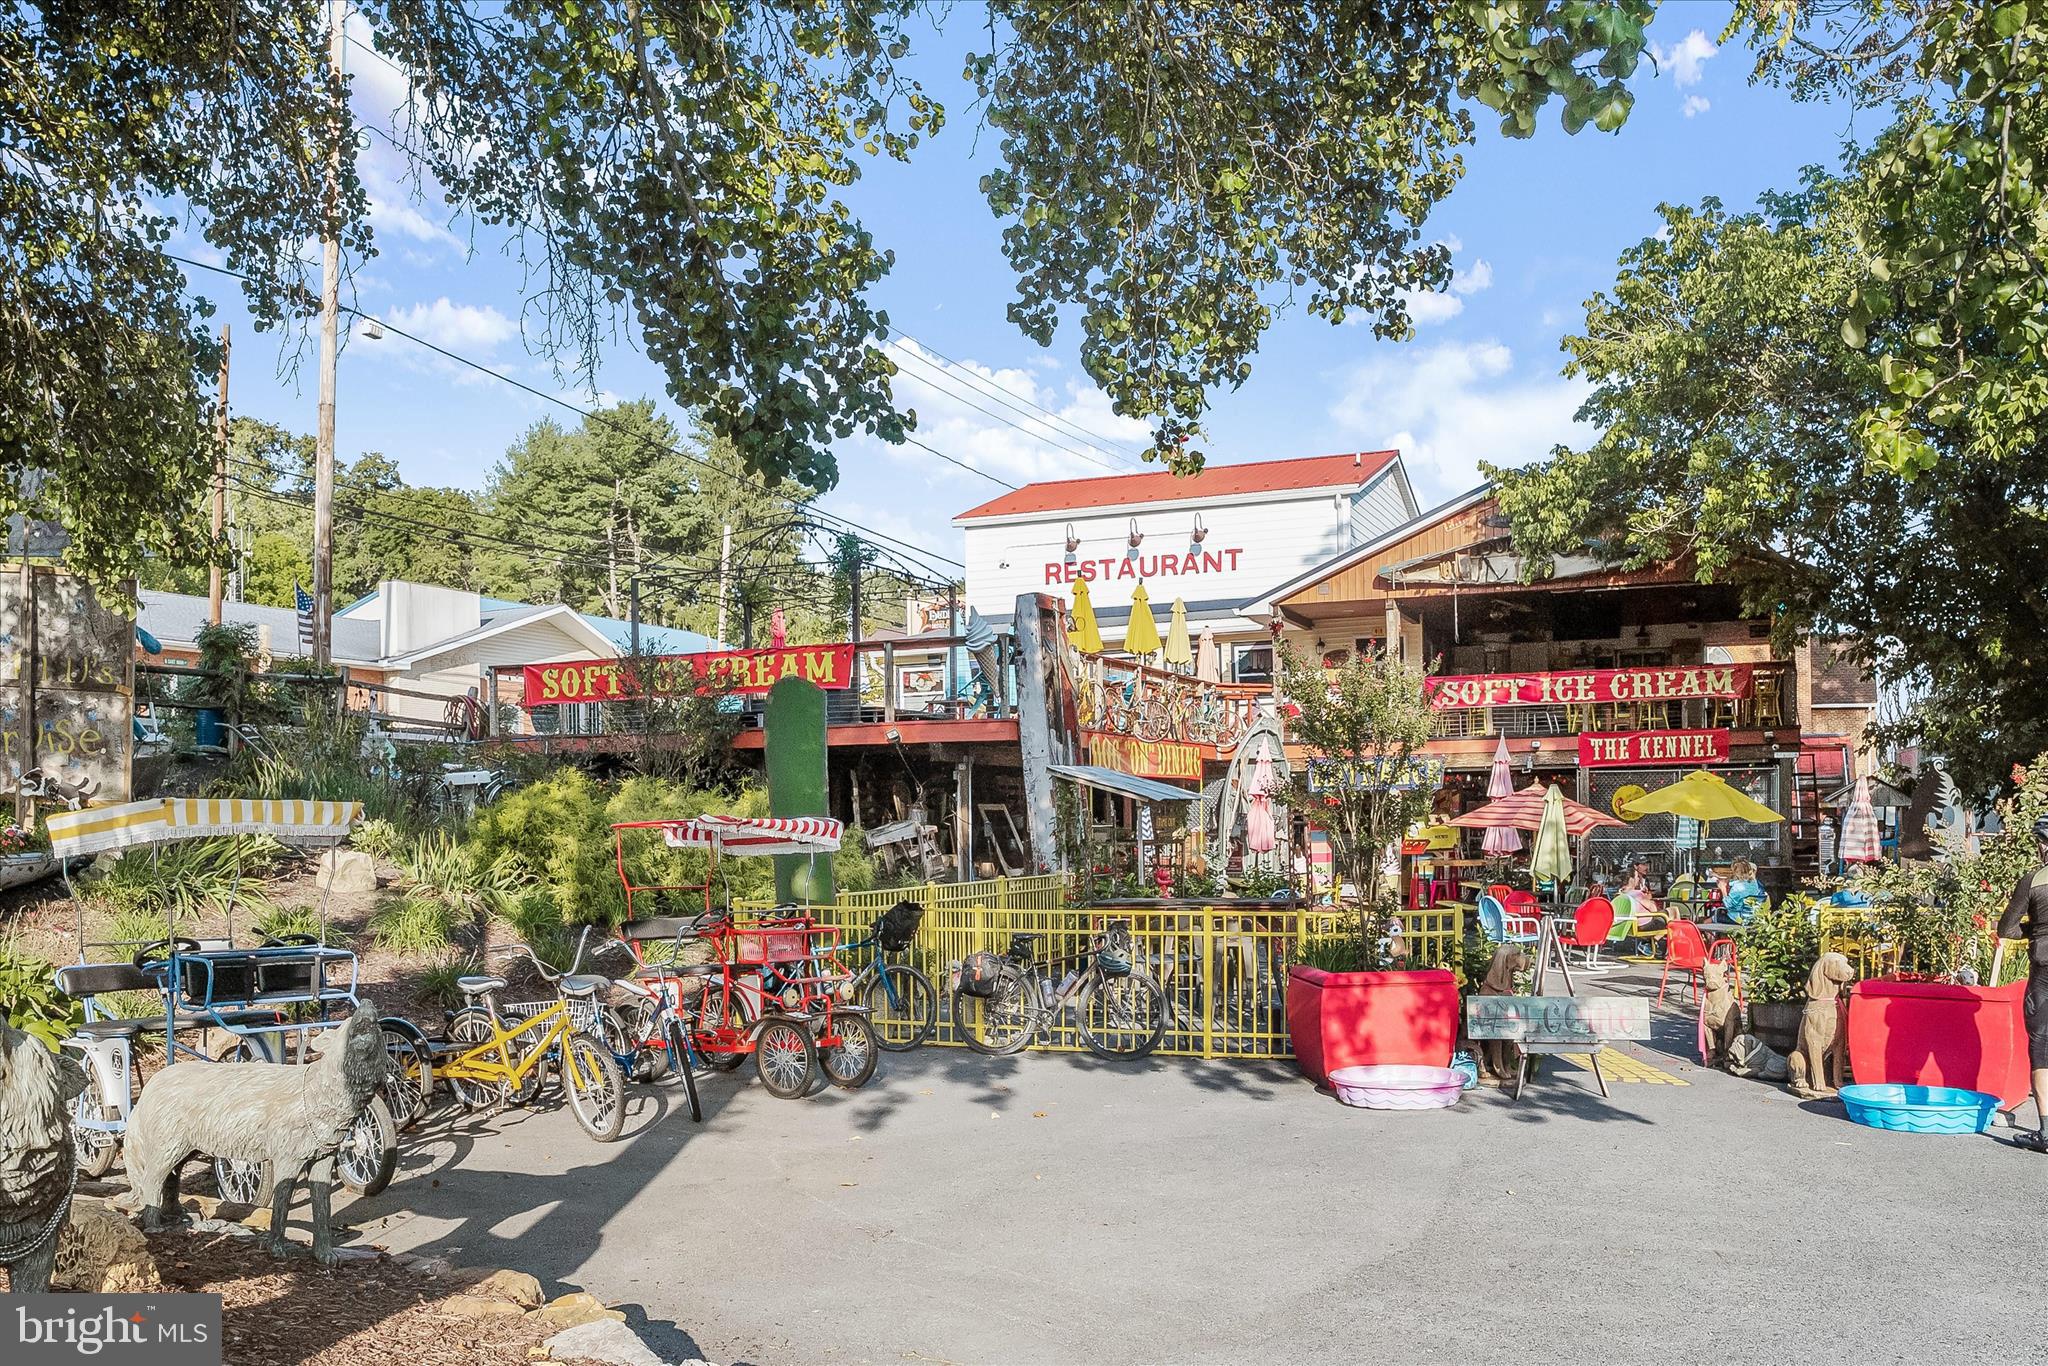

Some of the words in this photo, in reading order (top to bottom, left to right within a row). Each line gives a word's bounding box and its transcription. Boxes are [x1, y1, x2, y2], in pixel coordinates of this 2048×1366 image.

[1044, 548, 1243, 585] RESTAURANT
[541, 664, 625, 699] SOFT
[706, 651, 837, 688] CREAM
[1441, 678, 1526, 705] SOFT
[1540, 675, 1596, 702] ICE
[1609, 669, 1735, 699] CREAM
[1157, 743, 1201, 777] DINING
[1590, 737, 1629, 760] THE
[1639, 735, 1717, 759] KENNEL
